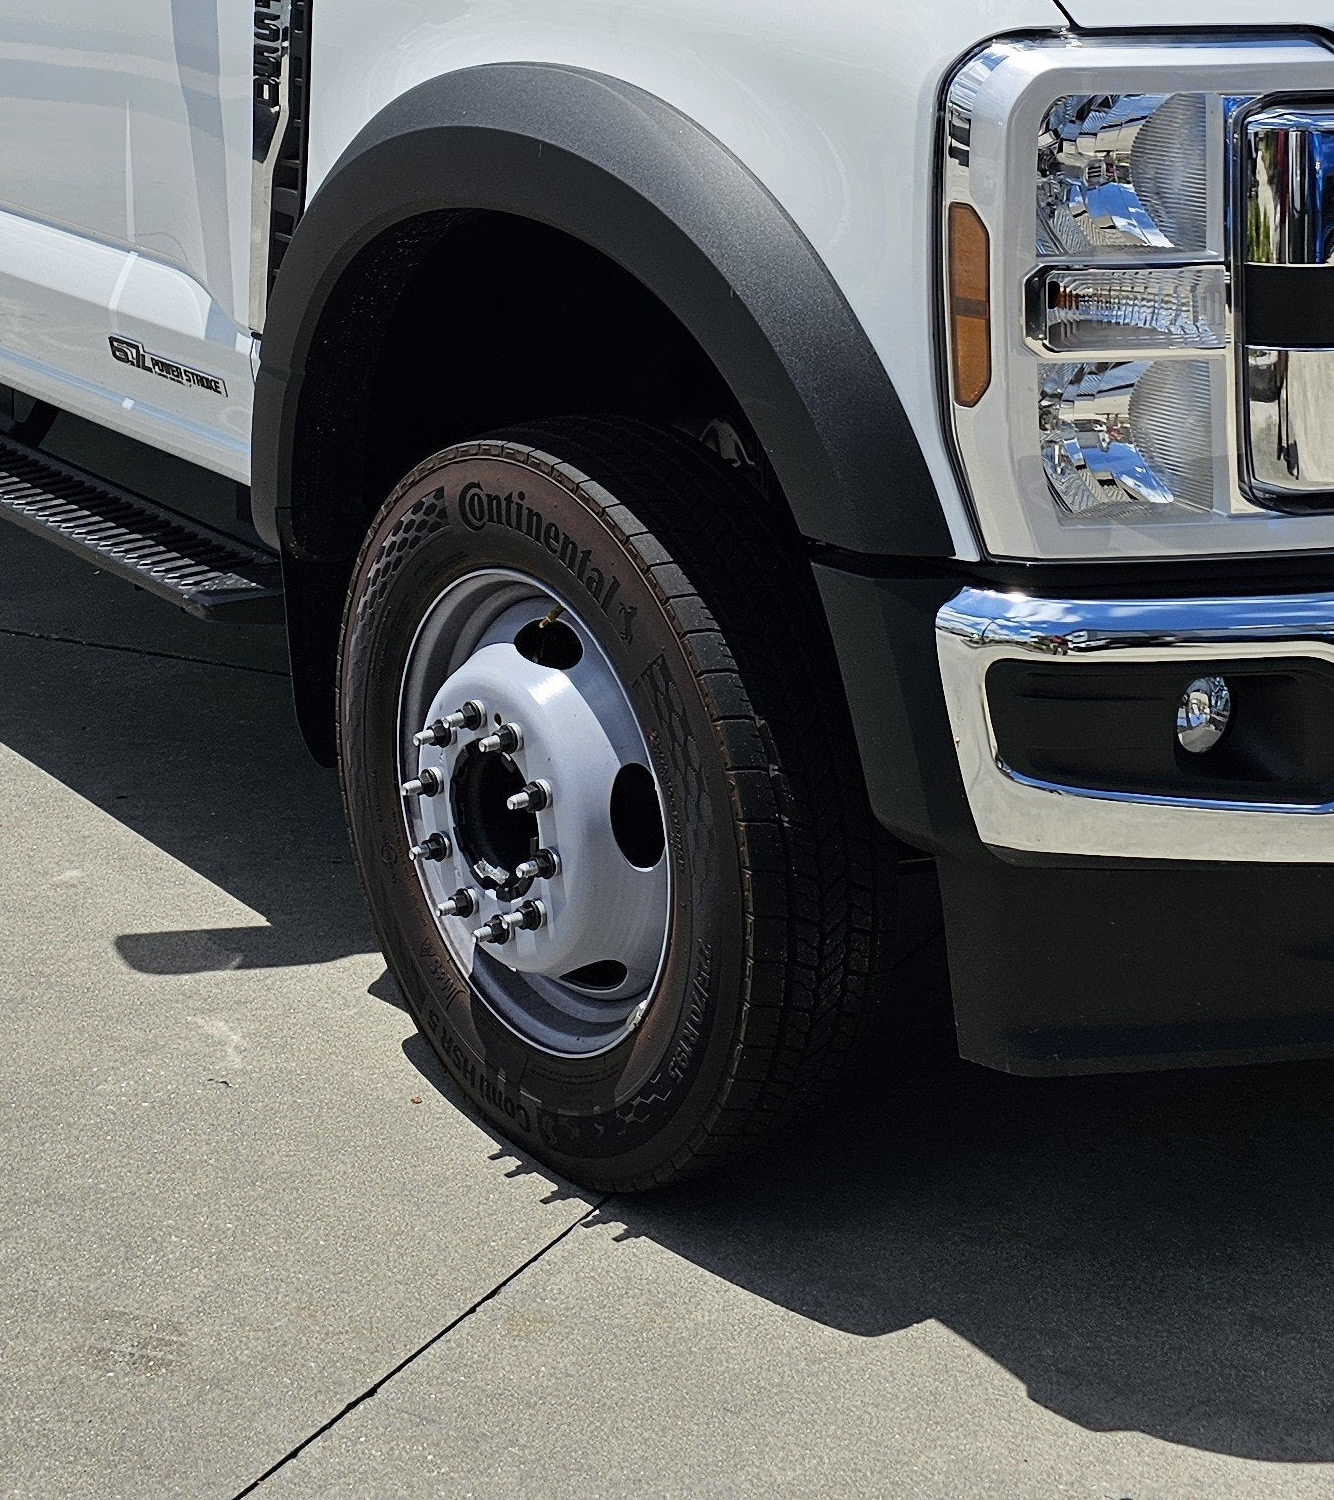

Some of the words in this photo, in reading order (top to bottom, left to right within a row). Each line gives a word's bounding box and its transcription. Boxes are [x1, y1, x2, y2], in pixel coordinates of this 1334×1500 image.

[108, 334, 153, 374] 6.7L
[151, 357, 184, 381] POWER
[183, 368, 222, 395] STROKE
[458, 480, 622, 613] Continental
[479, 1075, 532, 1134] Conti
